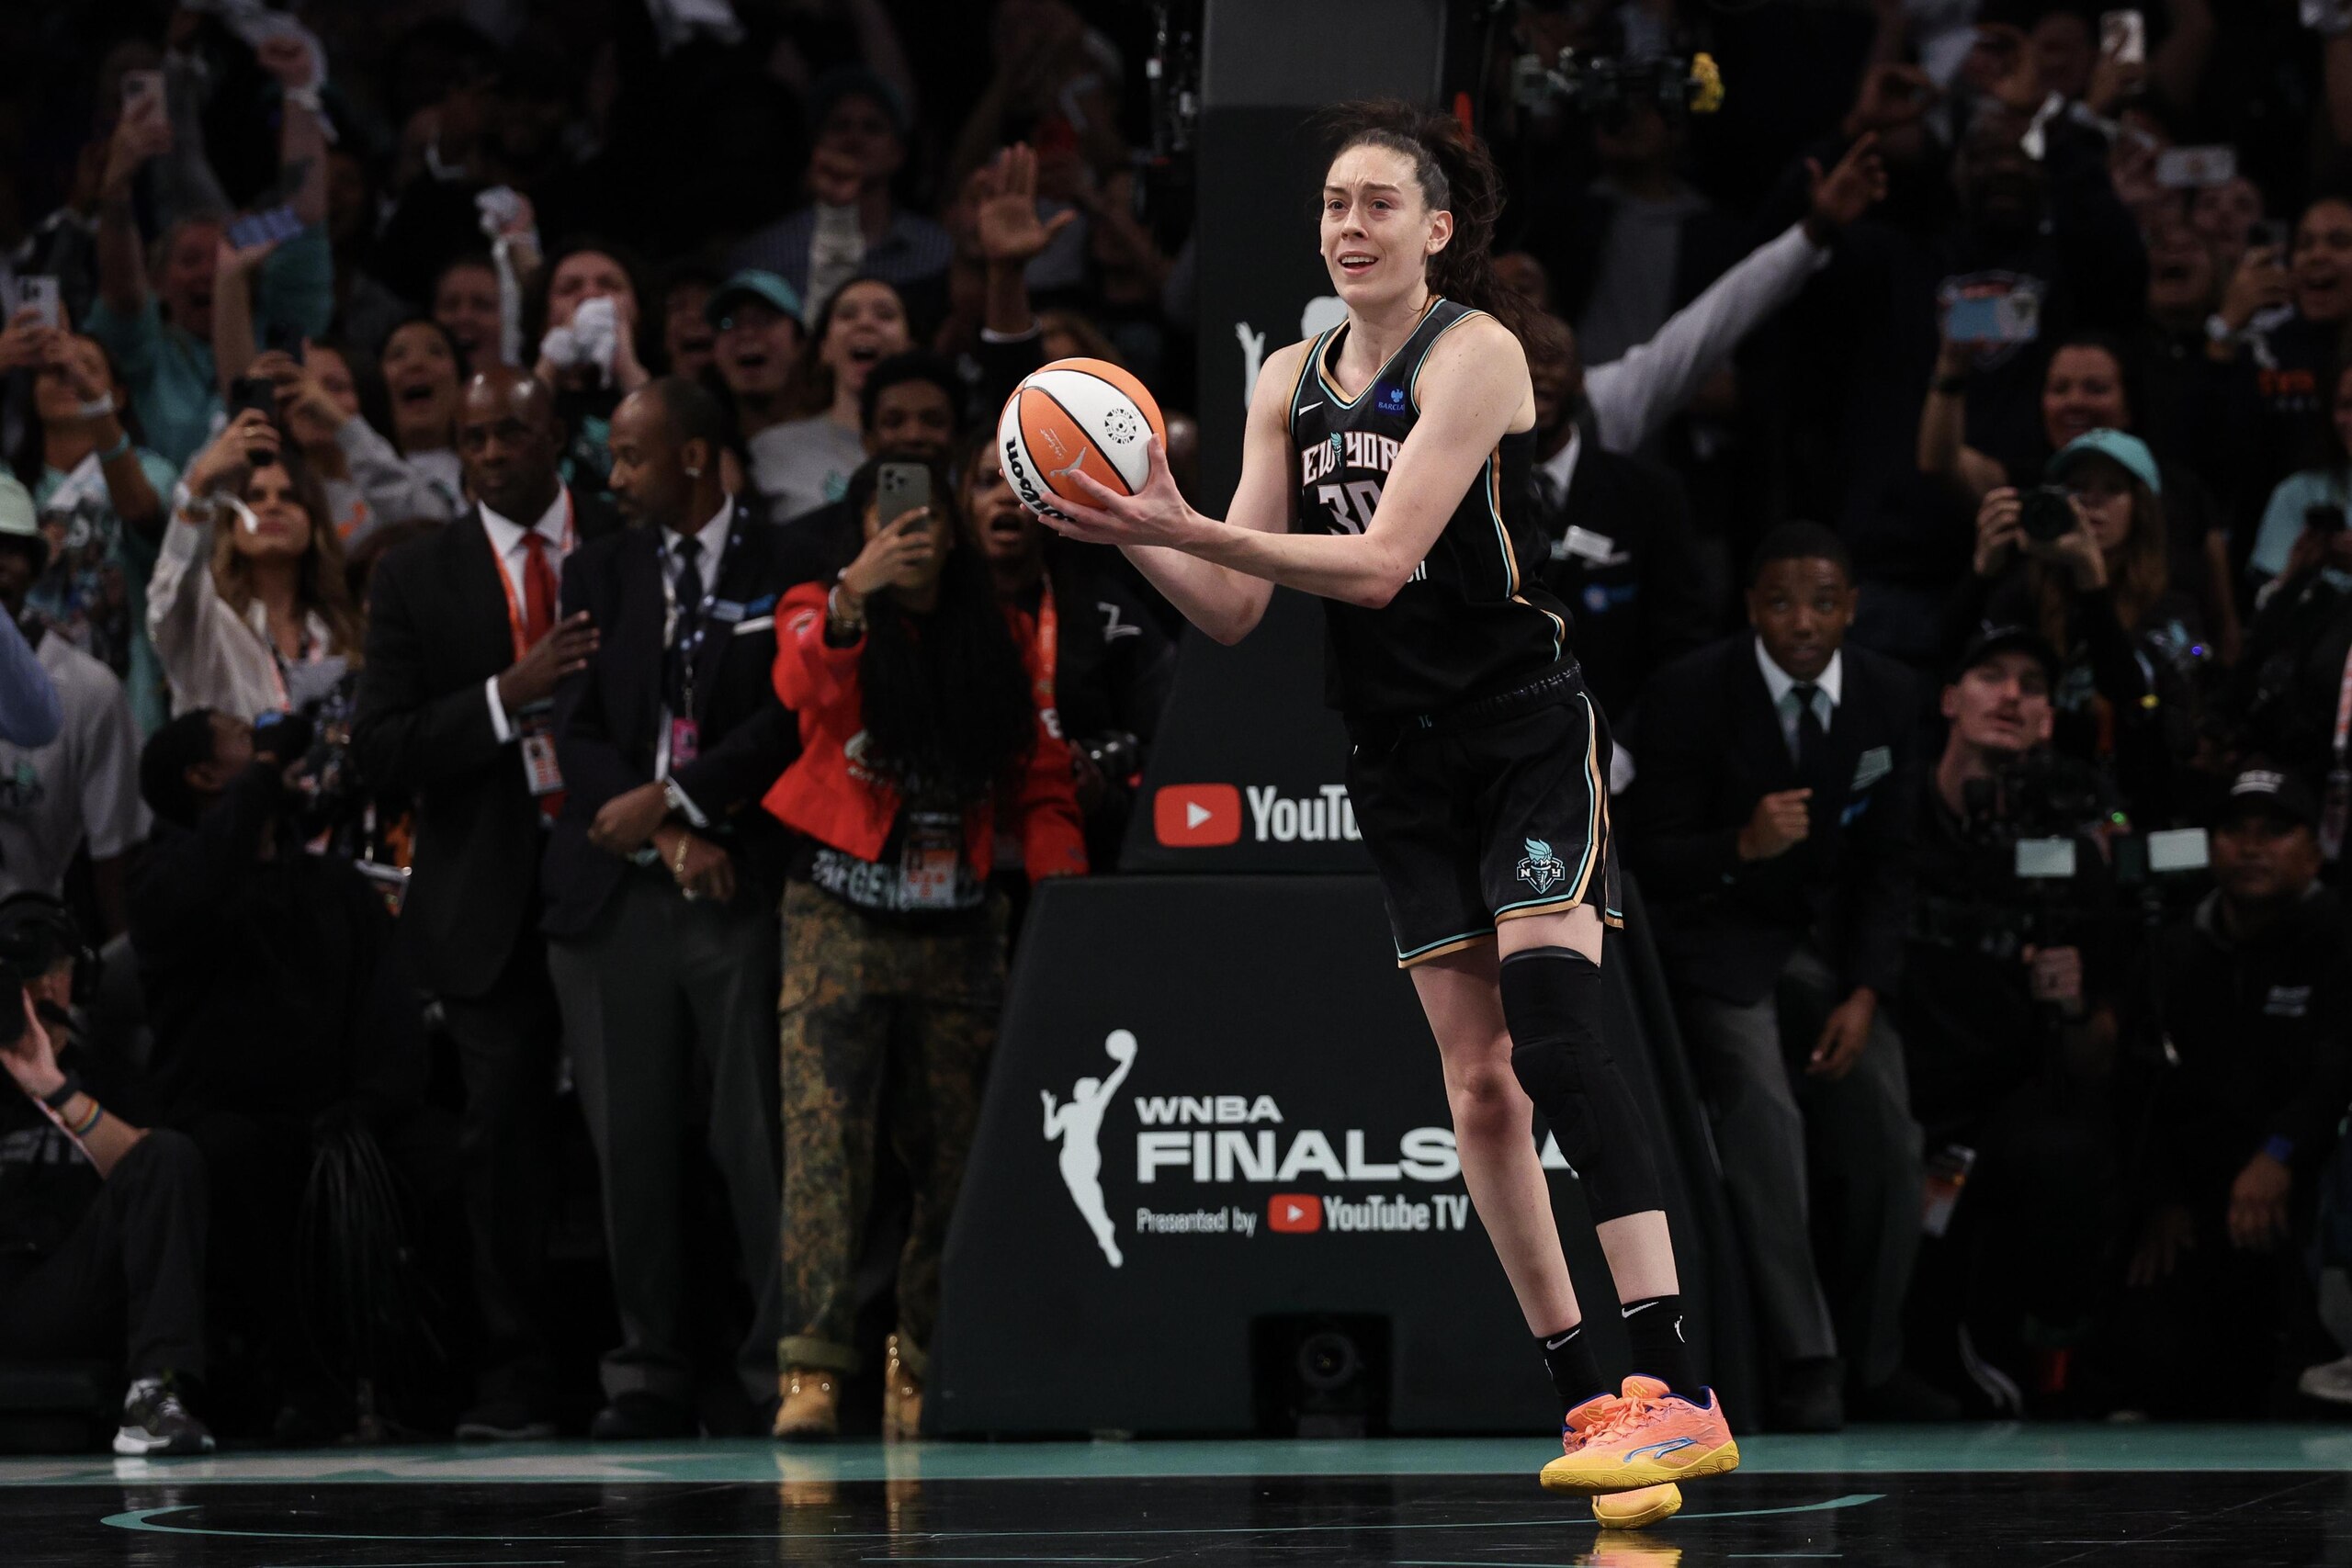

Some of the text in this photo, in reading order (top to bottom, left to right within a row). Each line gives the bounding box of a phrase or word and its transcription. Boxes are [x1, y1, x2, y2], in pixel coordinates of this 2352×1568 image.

[1378, 401, 1405, 411] BARCLA
[1302, 431, 1402, 487] EW YOR
[1245, 784, 1363, 842] YouTu
[1134, 1094, 1285, 1125] WNBA
[1136, 1126, 1463, 1183] FINALS
[1136, 1194, 1470, 1238] Presented by YouTube TV
